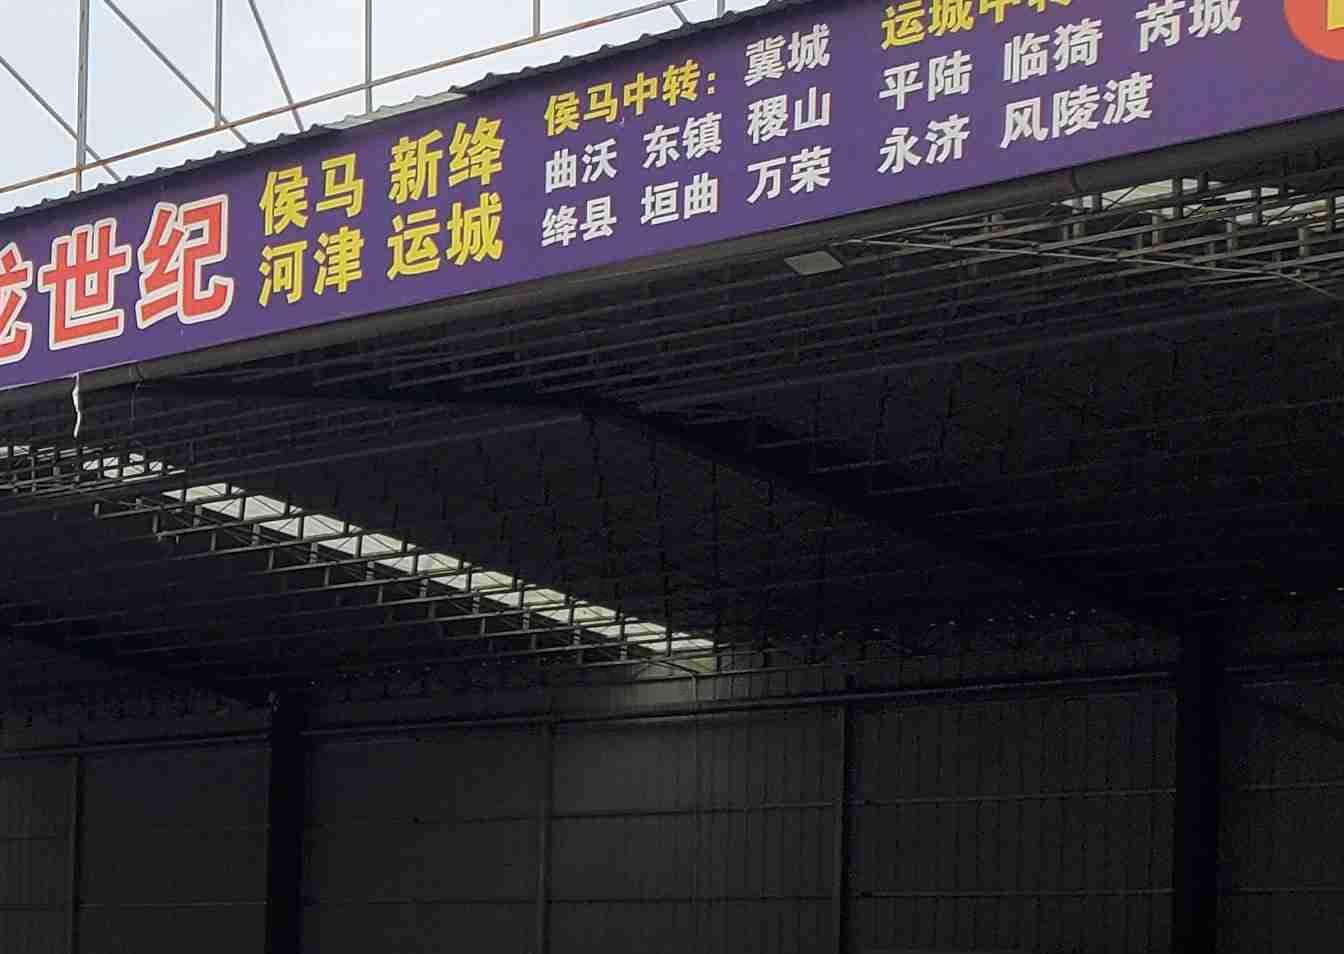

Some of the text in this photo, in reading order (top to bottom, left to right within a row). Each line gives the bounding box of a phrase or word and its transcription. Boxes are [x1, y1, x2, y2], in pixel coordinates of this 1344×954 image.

[544, 59, 716, 136] 侯马中转：
[879, 50, 972, 110] 平陆
[1003, 18, 1102, 83] 临猗
[545, 87, 831, 193] 曲沃 东镇 稷山
[877, 72, 1152, 173] 永济 风陵渡
[259, 117, 504, 235] 侯马 新绛
[542, 146, 831, 247] 绛县 垣曲 万荣
[259, 192, 503, 307] 河津 运城
